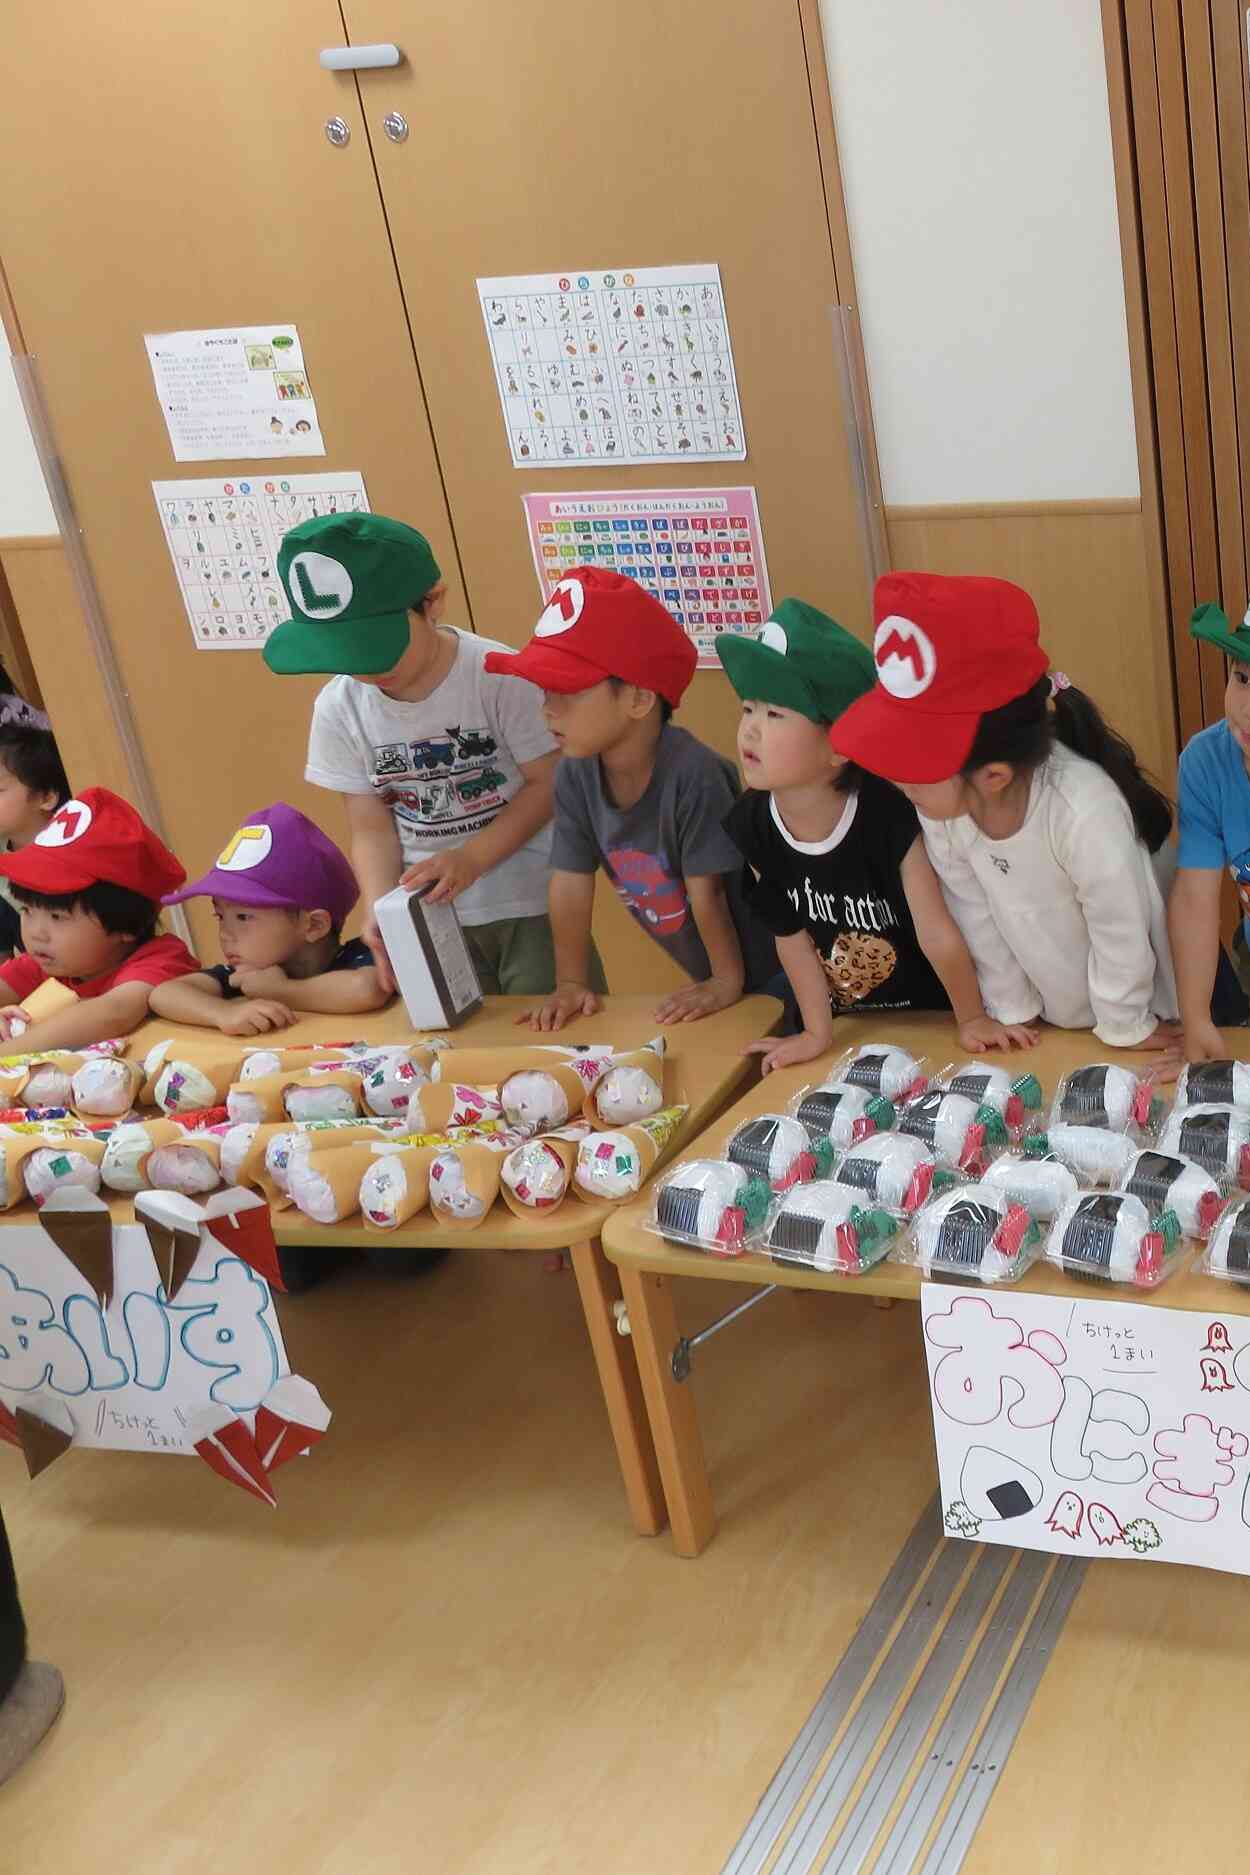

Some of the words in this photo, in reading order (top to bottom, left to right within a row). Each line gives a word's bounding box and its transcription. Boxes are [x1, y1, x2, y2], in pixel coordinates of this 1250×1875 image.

[293, 561, 341, 612] L
[551, 586, 576, 622] M
[876, 628, 925, 681] M
[50, 808, 82, 839] M
[416, 825, 458, 838] WORKING
[804, 876, 838, 925] for
[1082, 1320, 1136, 1339] ちけっと
[1110, 1343, 1154, 1361] 1まい
